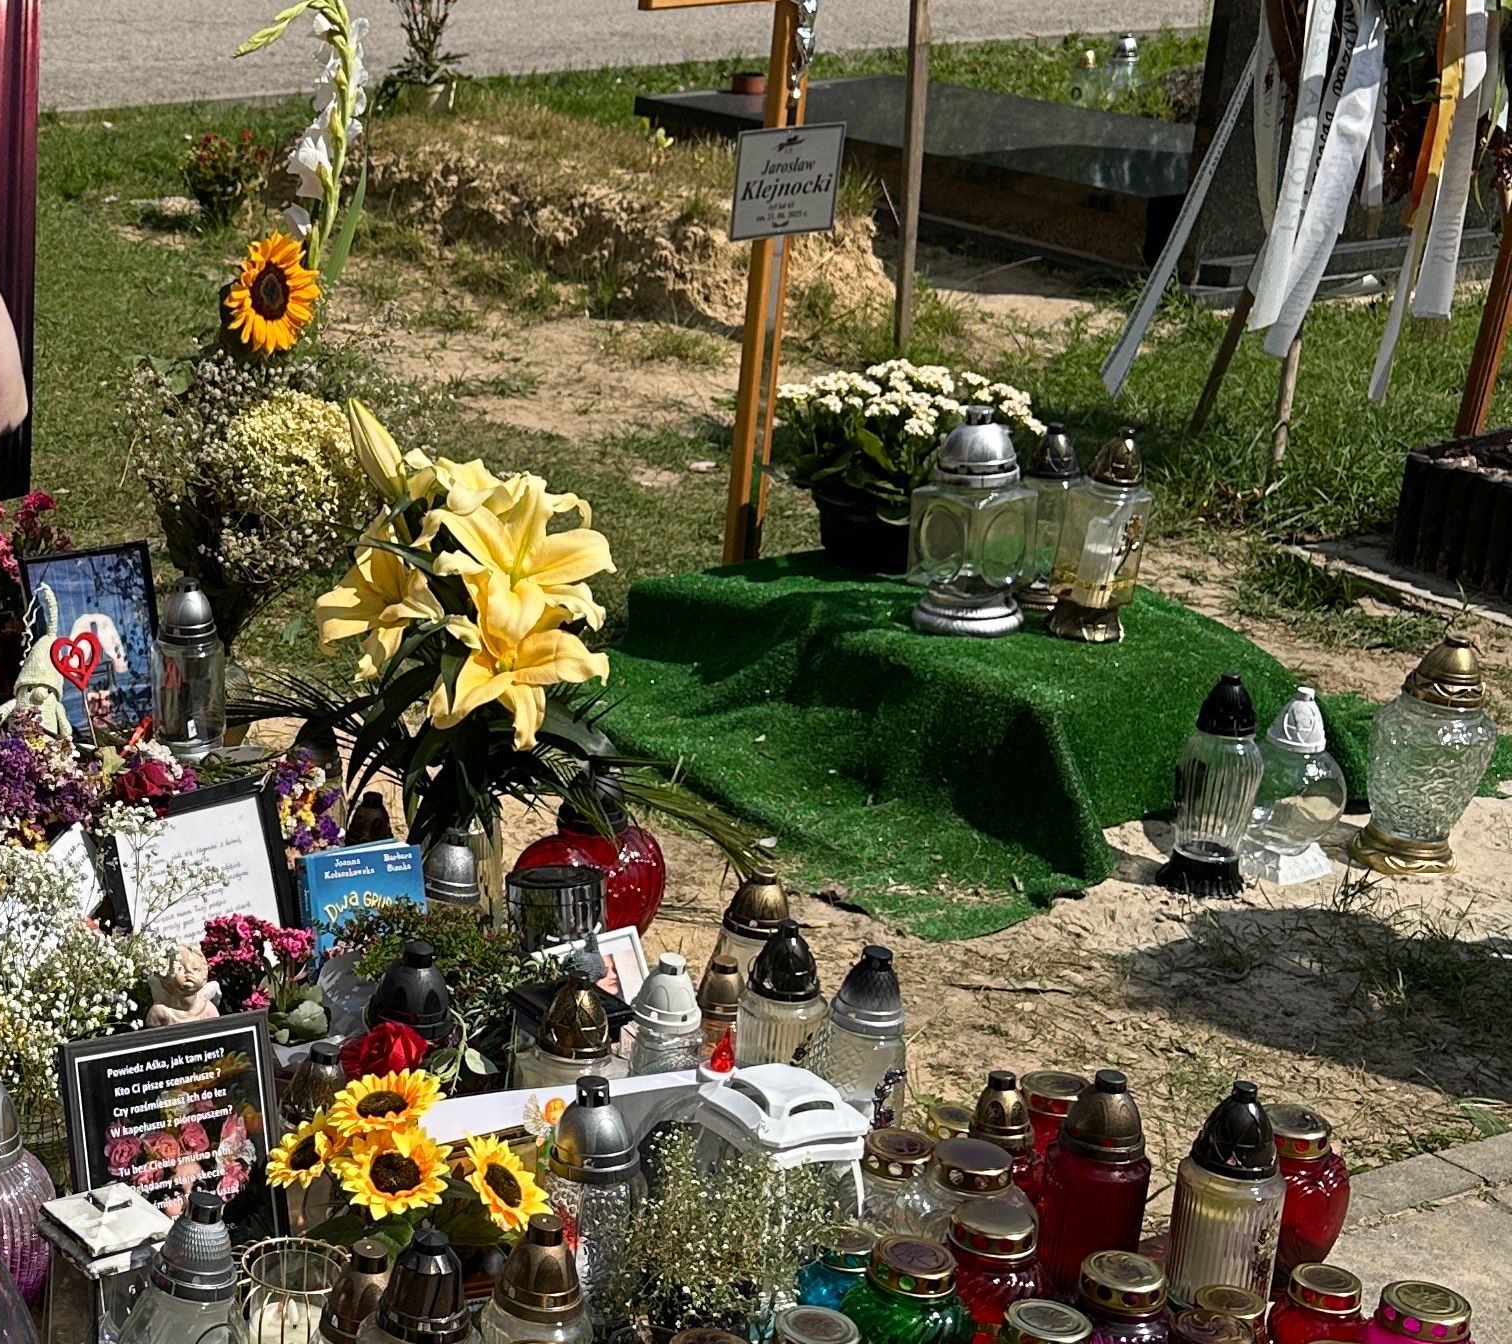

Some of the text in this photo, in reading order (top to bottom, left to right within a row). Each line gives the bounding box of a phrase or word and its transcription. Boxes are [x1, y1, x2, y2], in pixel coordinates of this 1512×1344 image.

[761, 157, 816, 175] Jarosław
[740, 173, 834, 204] Klejnocki
[107, 1047, 225, 1078] Powiedz Aśka, jak tam jest?
[114, 1086, 130, 1097] Kto
[132, 1083, 141, 1094] Ci
[142, 1079, 164, 1094] pisze
[165, 1070, 215, 1088] scenariusze
[113, 1105, 128, 1118] Czy
[201, 1090, 213, 1101] do
[110, 1129, 121, 1139] W
[122, 1121, 166, 1137] kapeluszu
[167, 1119, 172, 1127] z
[119, 1167, 131, 1178] Tu
[132, 1164, 147, 1175] bez
[148, 1158, 177, 1171] Ciebie
[177, 1152, 210, 1164] smutno
